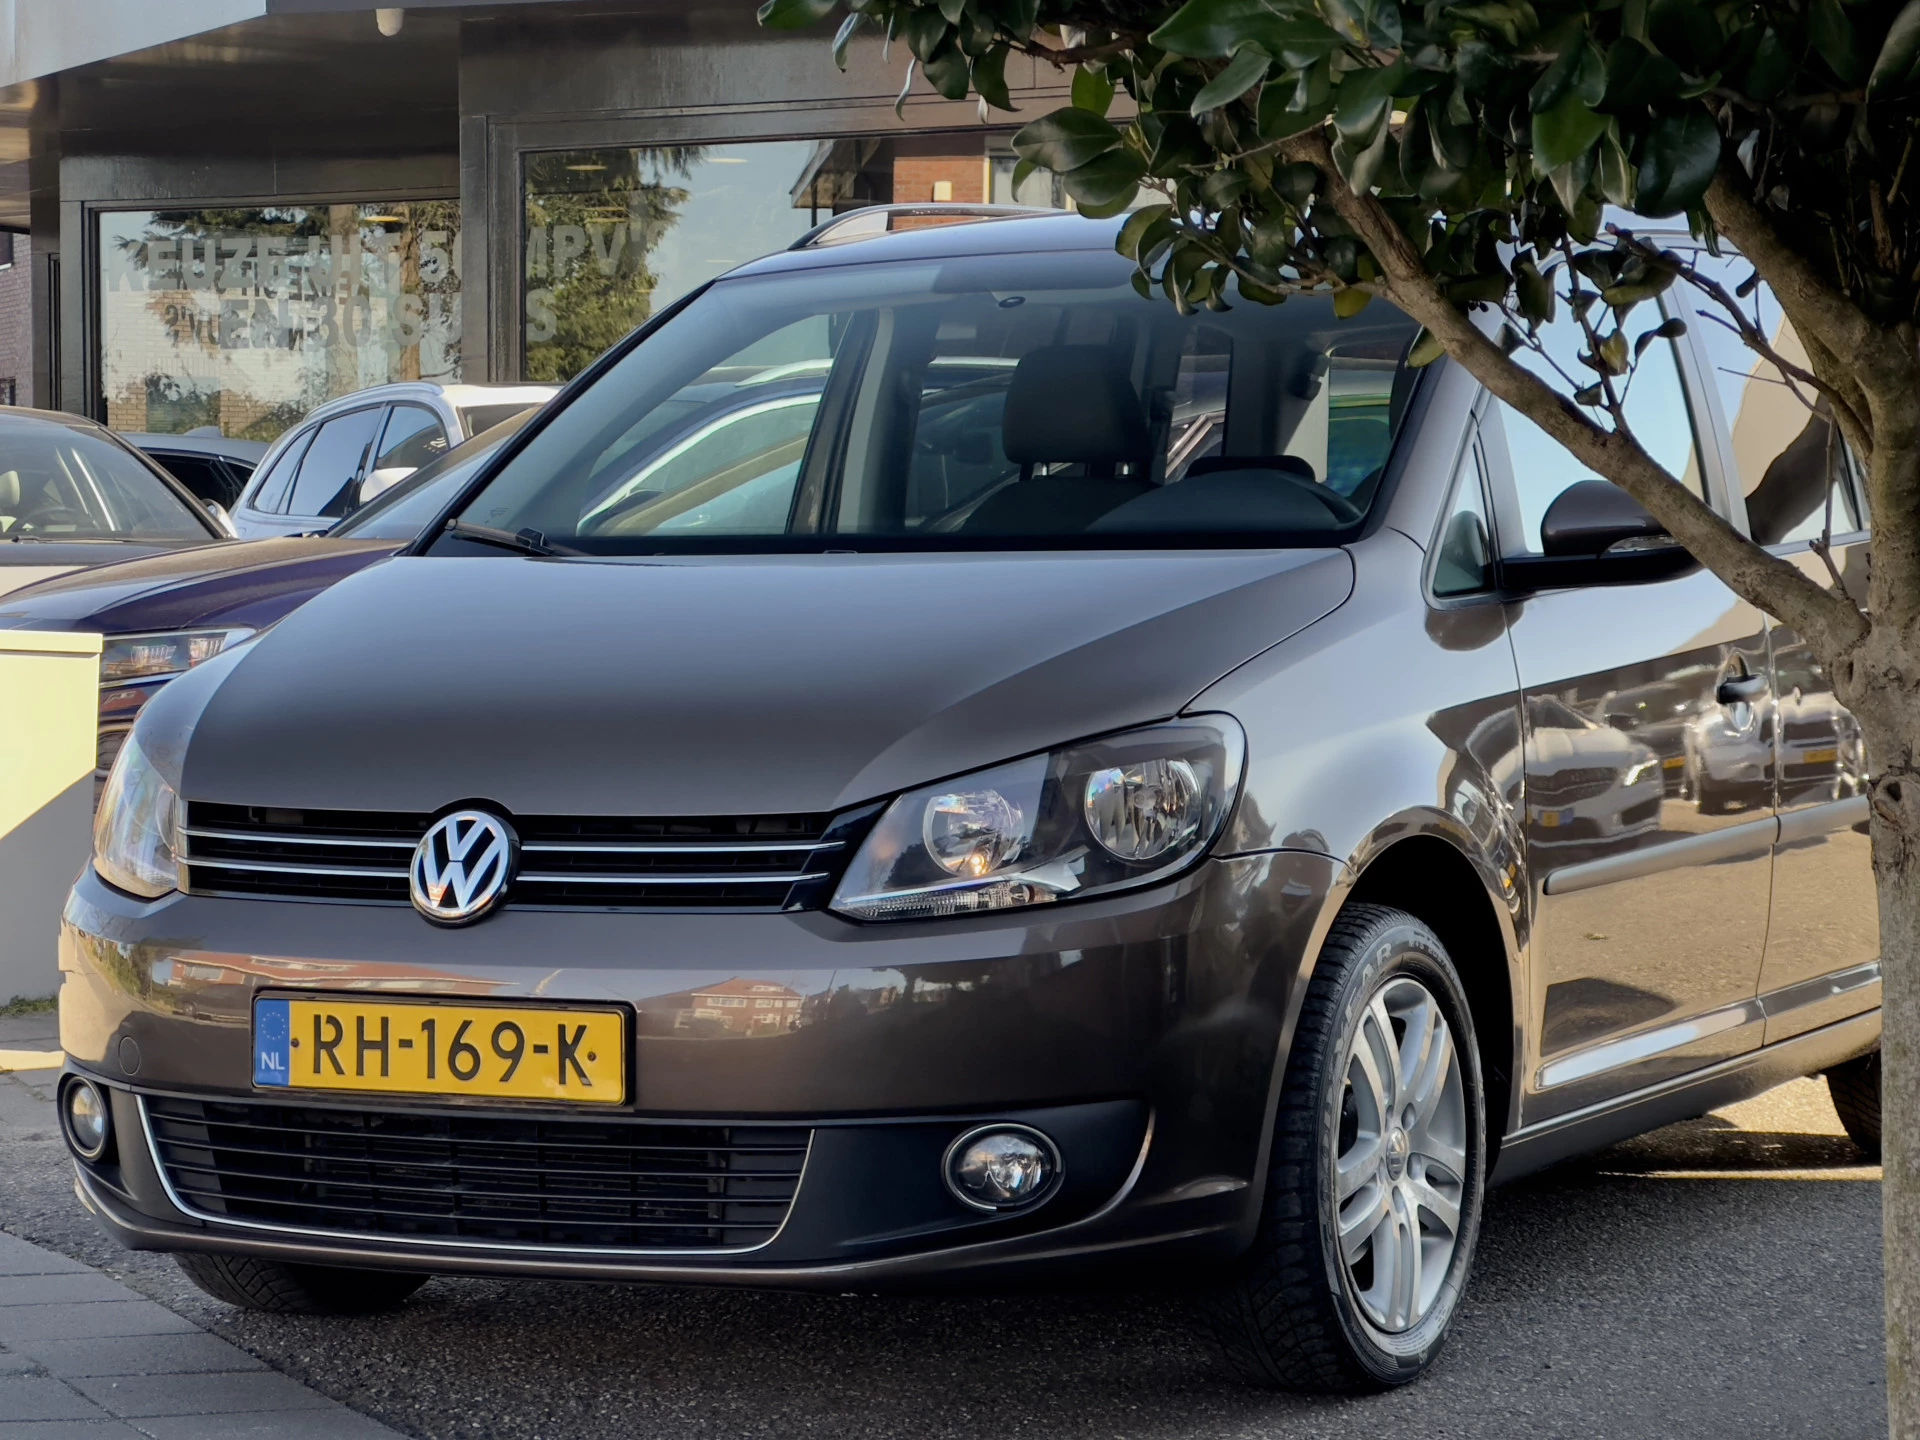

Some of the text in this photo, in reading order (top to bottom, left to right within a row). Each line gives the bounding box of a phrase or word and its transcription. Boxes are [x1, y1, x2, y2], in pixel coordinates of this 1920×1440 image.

[109, 236, 288, 292] KEUZE
[308, 232, 402, 288] UIT
[220, 297, 299, 350] EN
[316, 294, 372, 349] 30
[411, 811, 509, 919] VW
[260, 1051, 286, 1071] NL
[312, 1013, 593, 1087] RH-169-K
